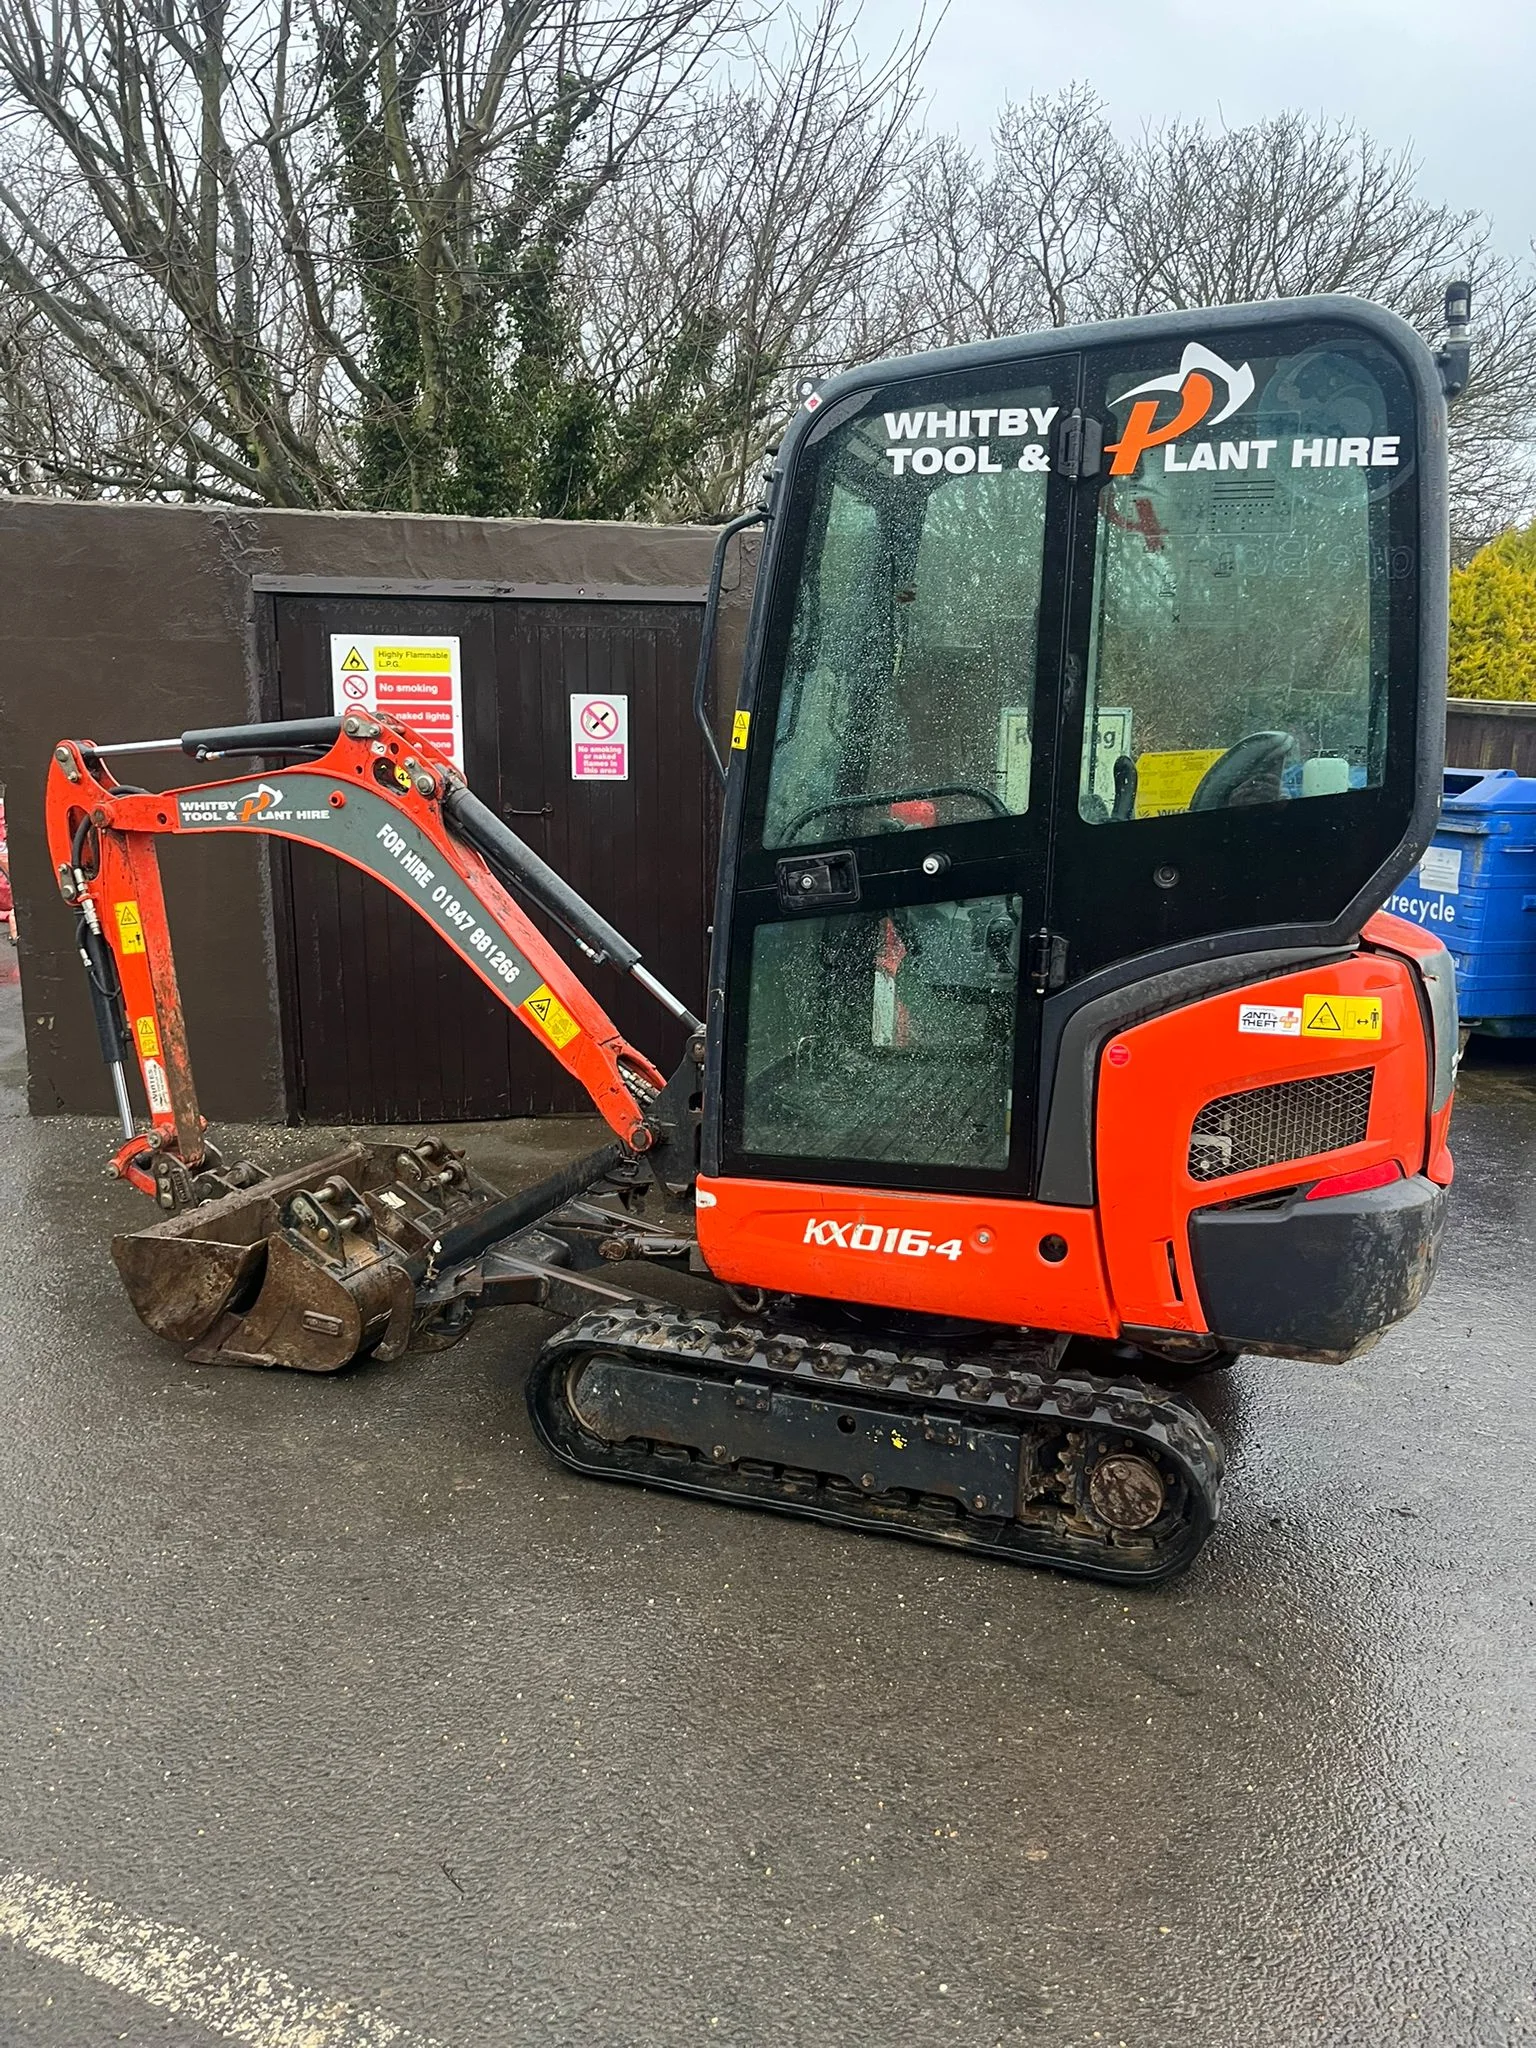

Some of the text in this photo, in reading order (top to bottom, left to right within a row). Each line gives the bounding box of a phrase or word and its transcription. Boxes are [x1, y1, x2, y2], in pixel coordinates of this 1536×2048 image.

[883, 406, 1060, 439] WHITBY
[886, 446, 1003, 475] TOOL
[1017, 444, 1052, 472] &
[1290, 436, 1400, 468] HIRE
[378, 650, 448, 660] Highly Flammable
[379, 682, 438, 696] No smoking
[396, 711, 424, 721] naked
[425, 711, 451, 722] lights
[578, 745, 622, 754] No smoking
[583, 759, 618, 767] flames in
[180, 801, 238, 811] WHITBY
[183, 811, 222, 822] TOOL
[225, 811, 237, 821] &
[296, 809, 330, 820] HIRE
[376, 823, 520, 984] FOR HIRE 01947 881266
[1242, 1010, 1271, 1020] ANTI
[1241, 1019, 1278, 1028] THEFT
[802, 1217, 963, 1261] KX016-4
